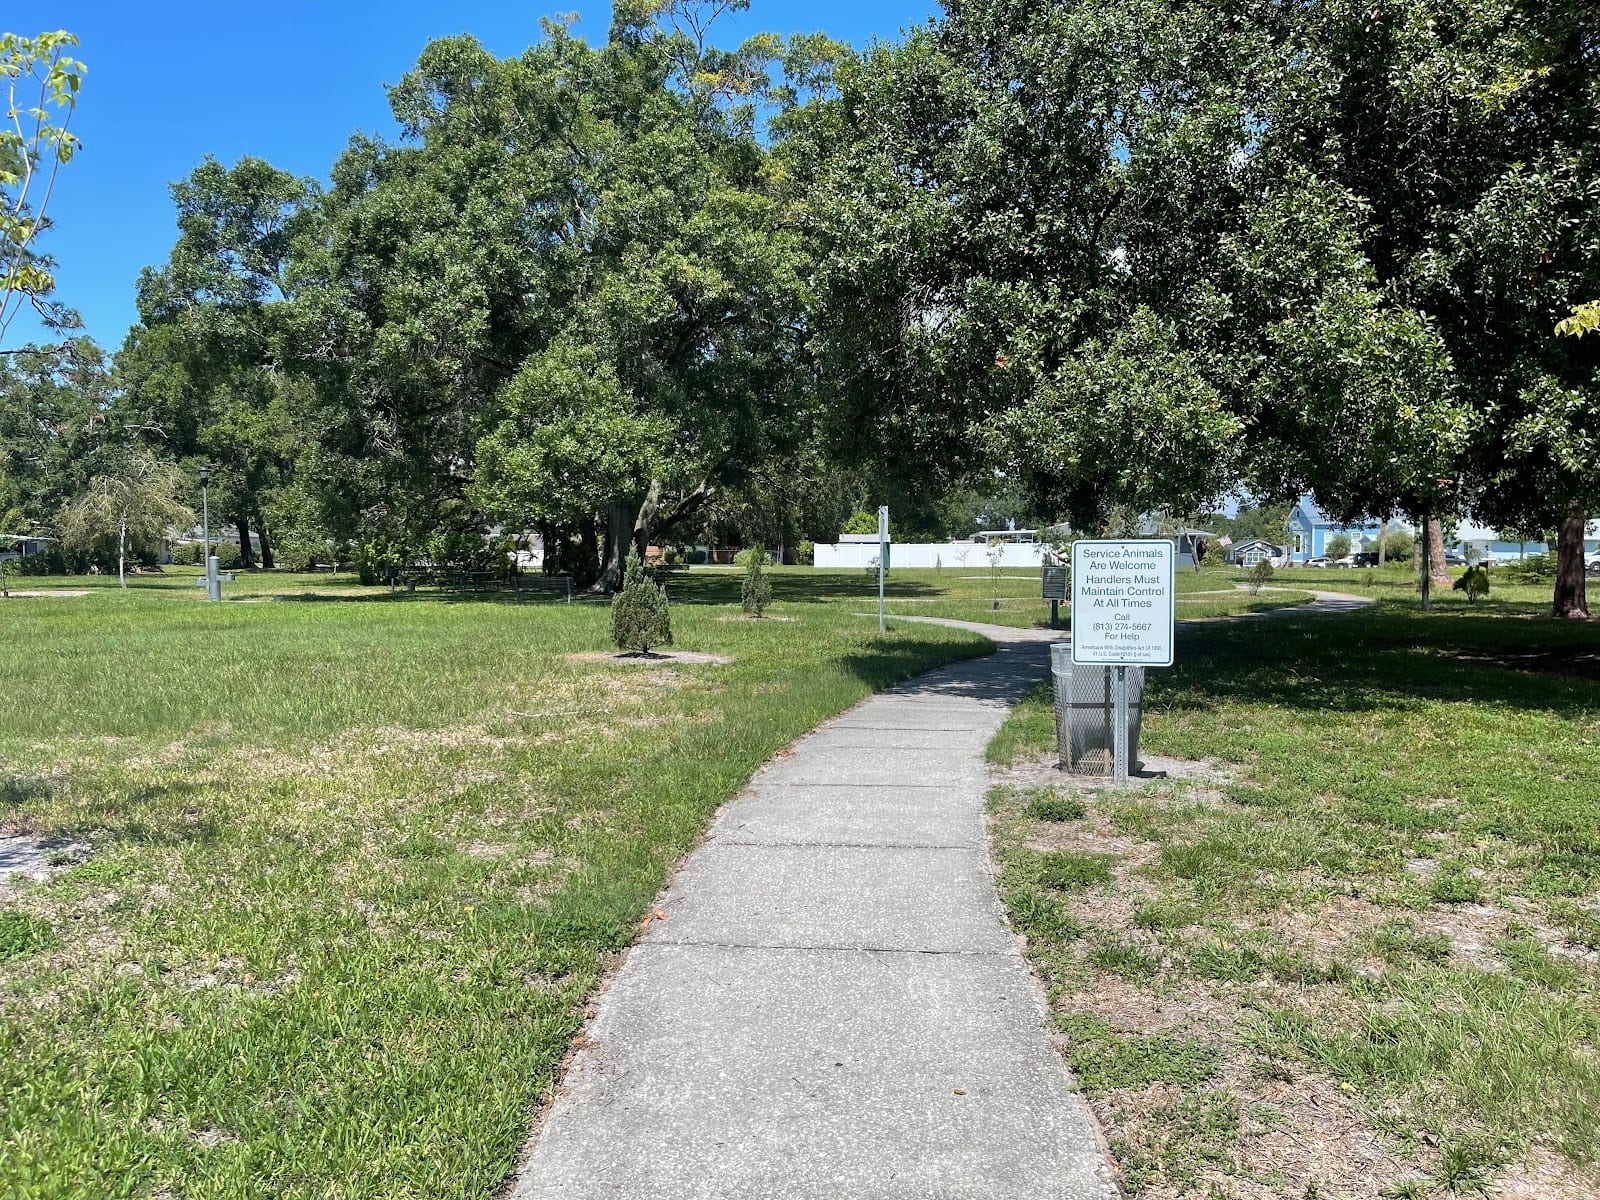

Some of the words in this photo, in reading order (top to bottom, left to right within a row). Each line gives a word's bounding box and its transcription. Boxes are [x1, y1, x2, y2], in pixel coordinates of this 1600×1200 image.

[1083, 549, 1120, 558] Service
[1122, 549, 1164, 558] Animals
[1089, 561, 1107, 570] Are
[1109, 561, 1156, 570] Welcome
[1086, 575, 1131, 584] Handlers
[1134, 575, 1160, 584] Must
[1081, 587, 1124, 596] Maintain
[1127, 587, 1165, 596] Control
[1093, 599, 1104, 608] At
[1106, 599, 1119, 608] All
[1121, 599, 1152, 608] Times
[1114, 613, 1130, 621] Call
[1092, 622, 1113, 631] (813)
[1114, 623, 1152, 631] 274-5667
[1104, 632, 1118, 640] For
[1120, 632, 1140, 641] Help
